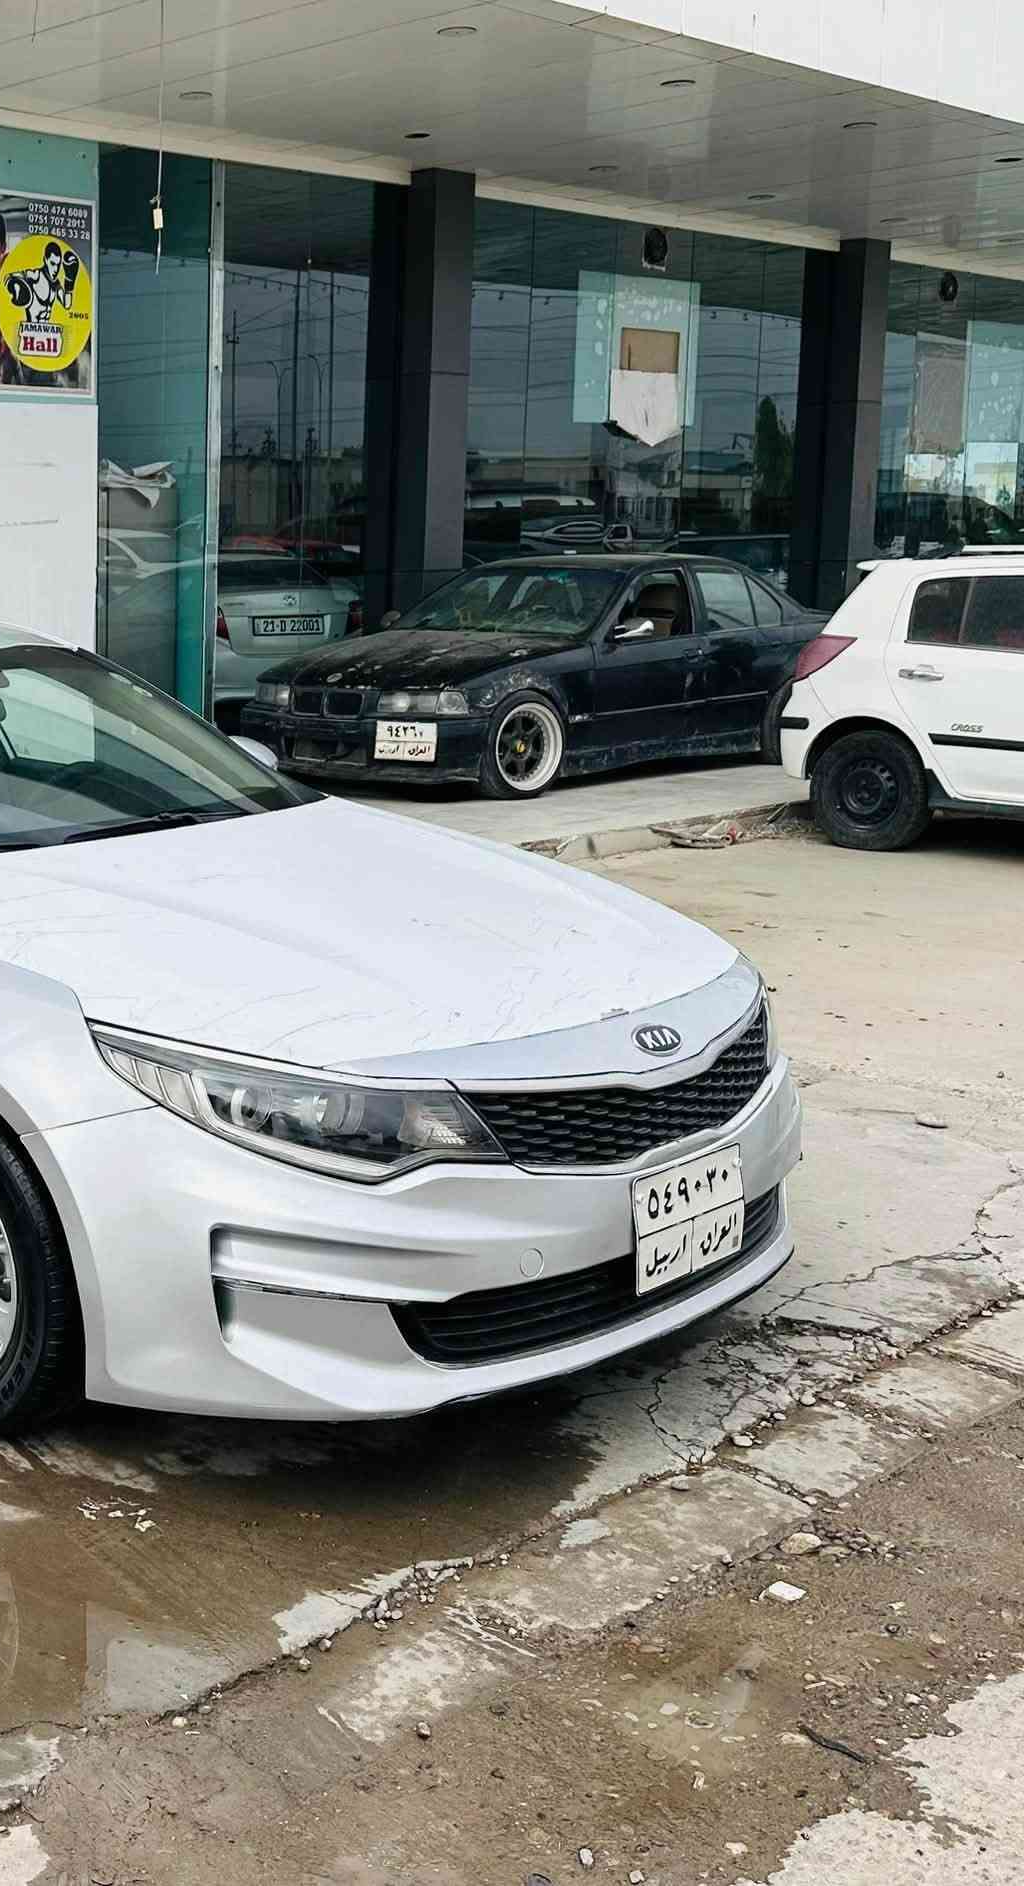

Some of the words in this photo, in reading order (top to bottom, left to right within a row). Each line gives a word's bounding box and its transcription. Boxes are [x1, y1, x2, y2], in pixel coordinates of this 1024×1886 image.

[28, 202, 49, 214] 0750
[28, 213, 48, 224] 0751
[28, 224, 49, 234] 0750
[22, 335, 58, 353] Hall
[639, 1027, 680, 1049] KIA
[646, 1166, 729, 1220] ٥٤٩٠٣٠
[699, 1211, 738, 1257] العراق
